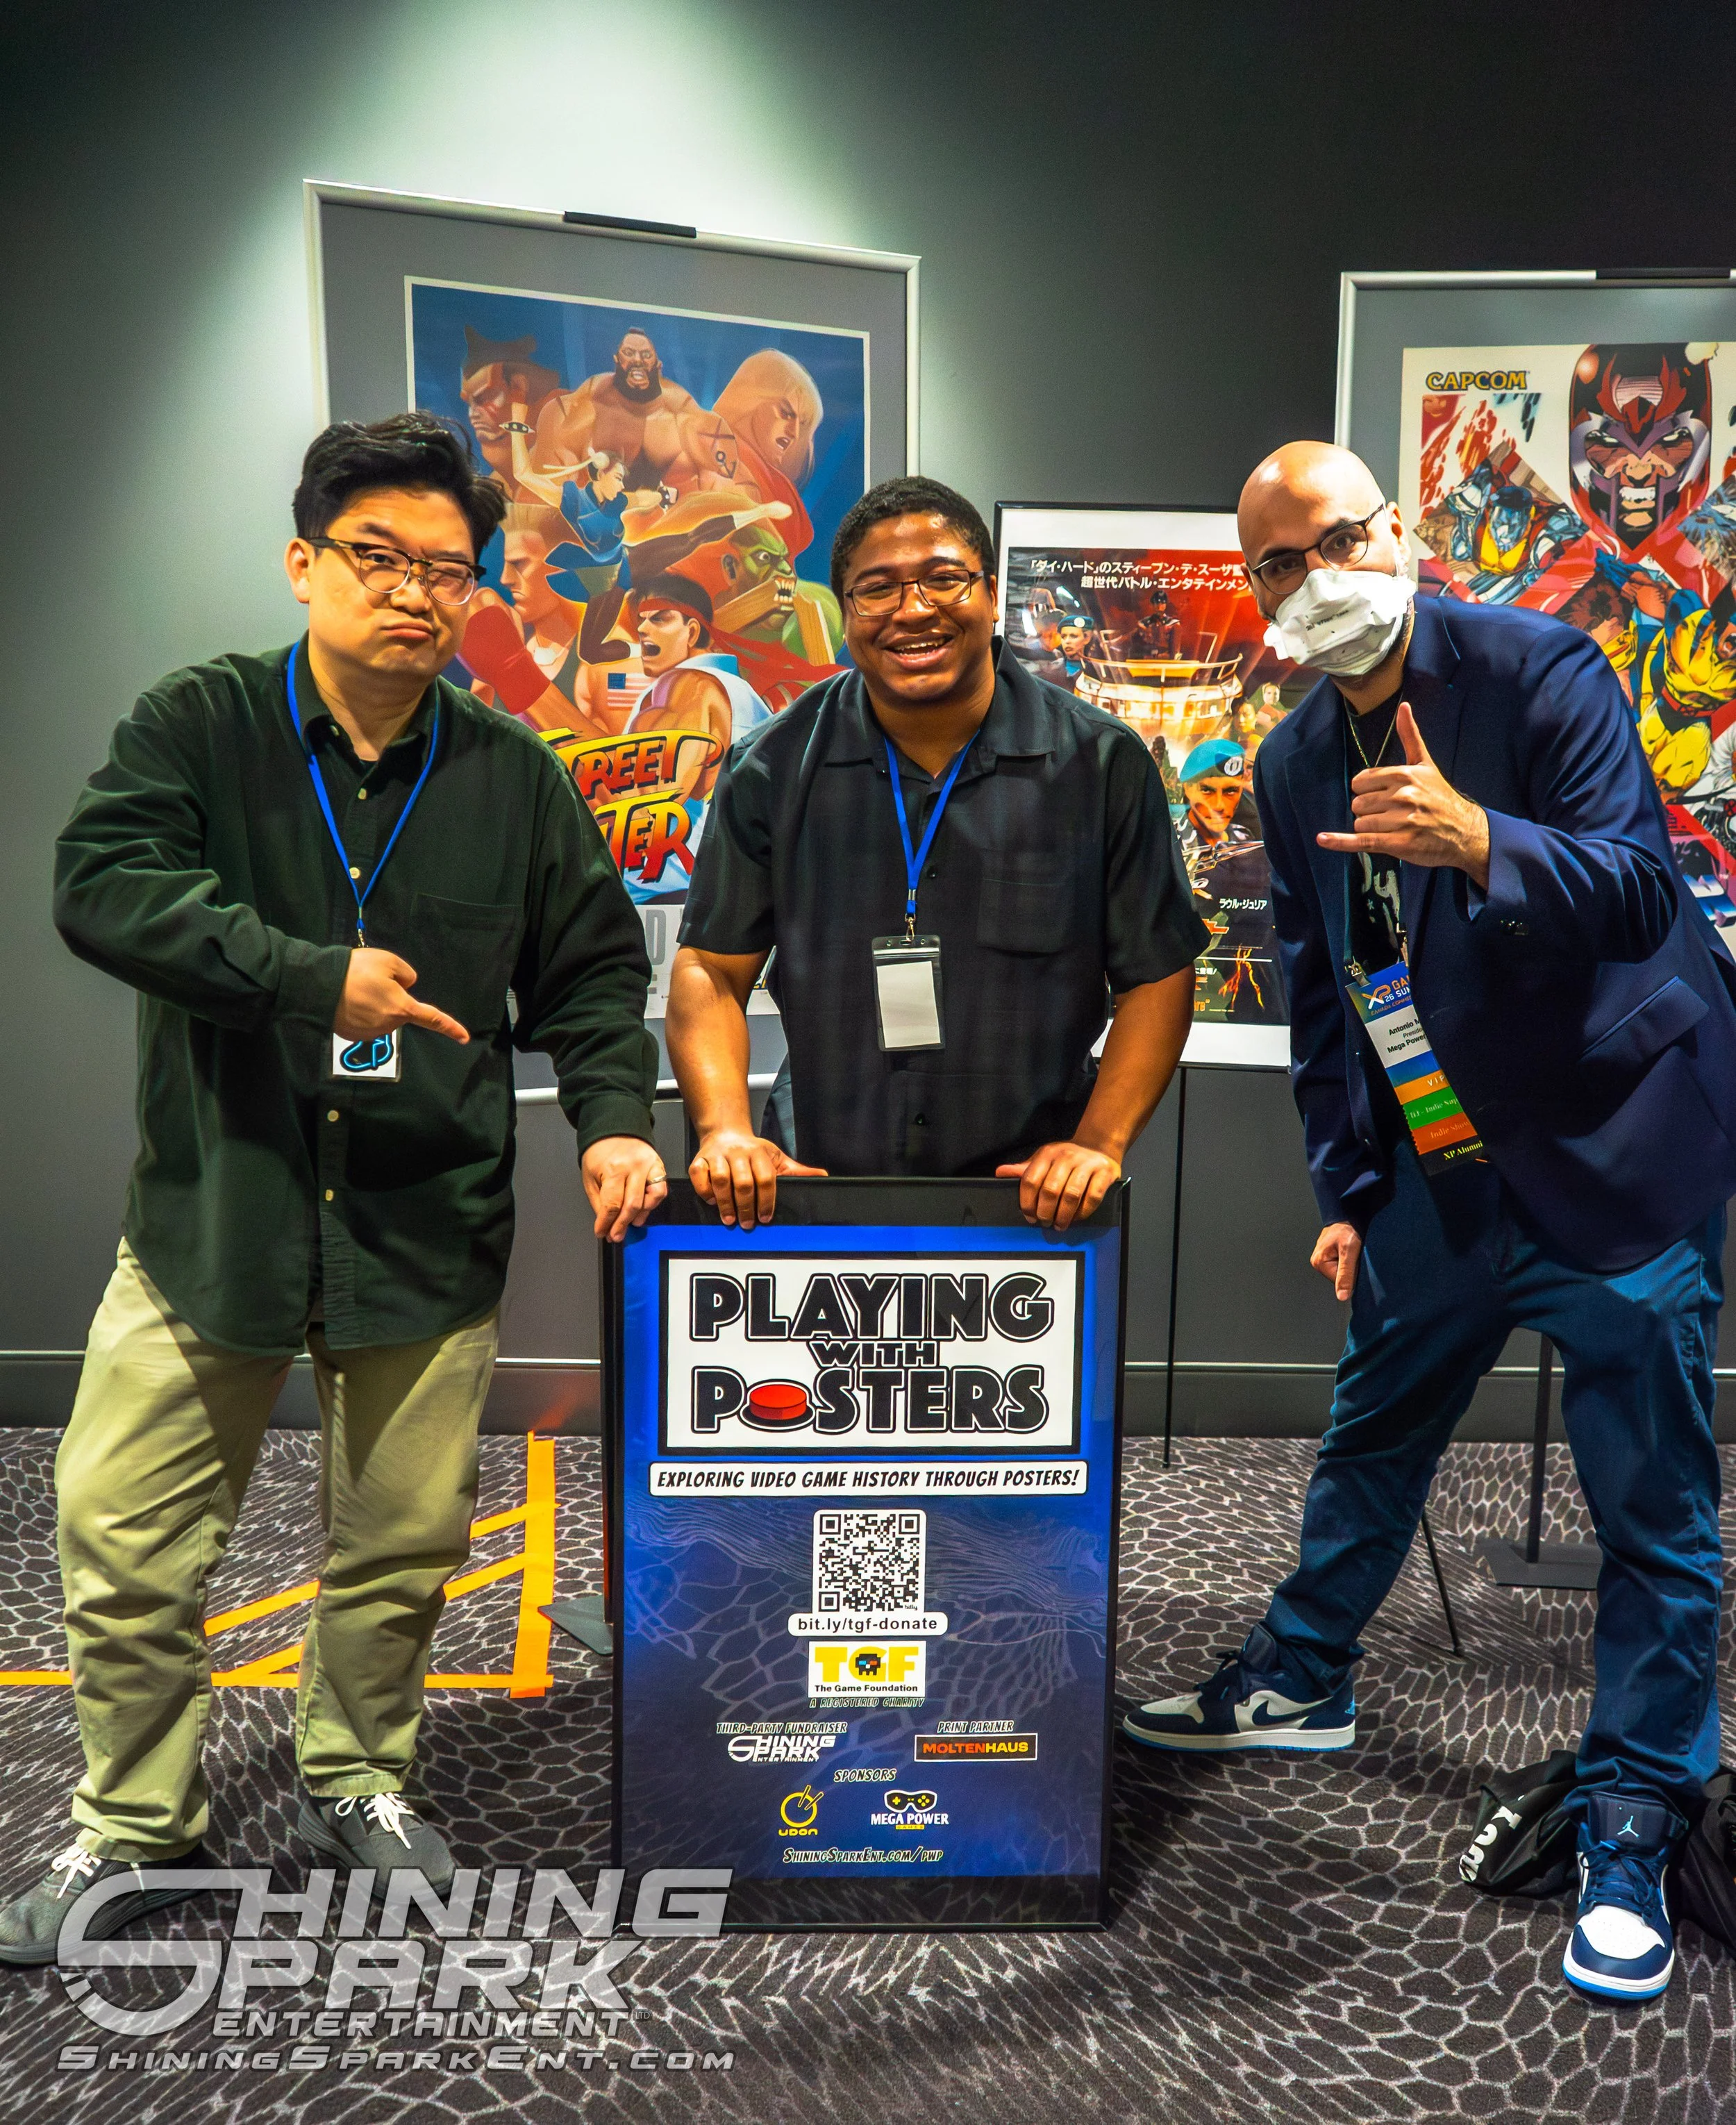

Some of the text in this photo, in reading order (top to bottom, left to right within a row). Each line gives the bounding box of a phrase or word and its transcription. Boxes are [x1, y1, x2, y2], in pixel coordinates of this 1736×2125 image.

[1426, 371, 1527, 391] CAPCOM
[539, 727, 724, 799] TREET
[1389, 1022, 1414, 1035] Antonio
[1387, 1043, 1406, 1053] Mega
[1457, 1140, 1483, 1156] Alumni
[690, 1273, 1054, 1342] PLAYING
[806, 1339, 940, 1368] WITH
[658, 1469, 1080, 1488] EXPLORING VIDEO GAME HISTORY THROUGH POSTERS!
[798, 1617, 937, 1633] bit.ly/tgf-donate
[815, 1646, 919, 1682] TGF
[809, 1697, 925, 1708] A REGISTERED CHARITY
[716, 1722, 848, 1734] THIRD-PARTY FUNDRAISER
[937, 1720, 1015, 1733] PRINT PARTNER
[728, 1735, 836, 1747] SHINING
[922, 1742, 1029, 1754] MOLTENHAUS
[833, 1768, 897, 1782] SPONSORS
[871, 1813, 949, 1825] MEGA POWER
